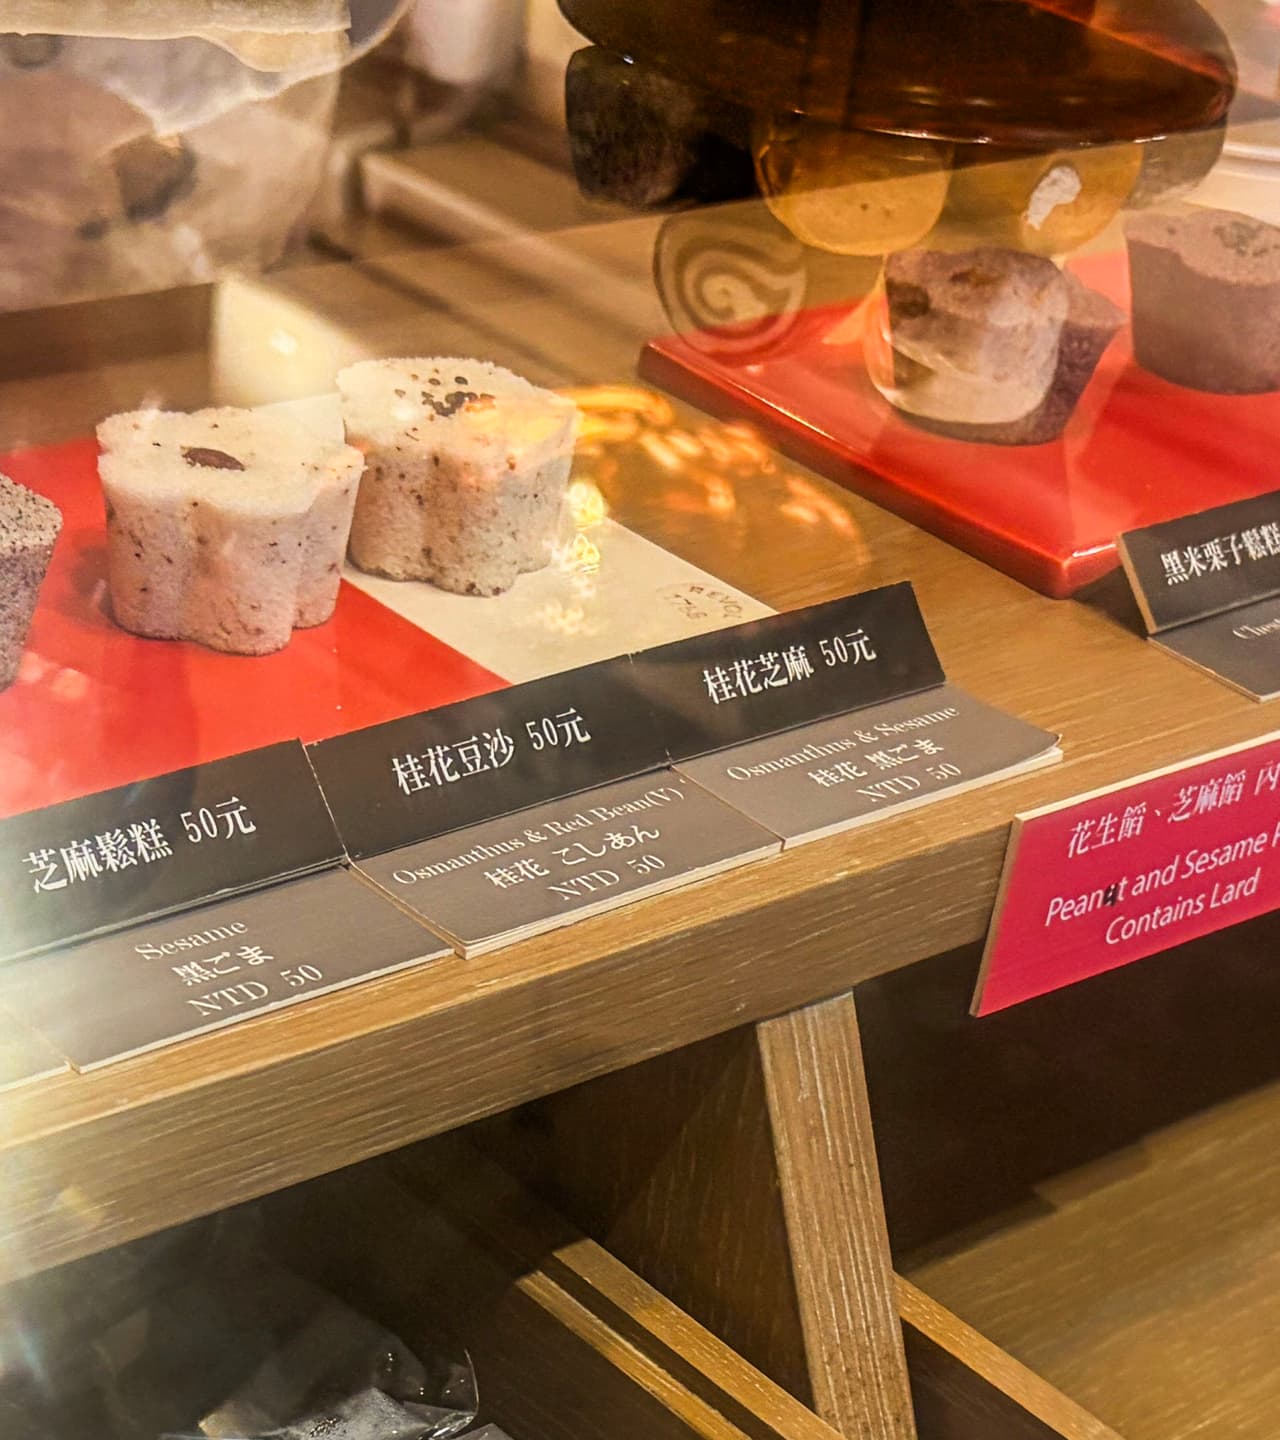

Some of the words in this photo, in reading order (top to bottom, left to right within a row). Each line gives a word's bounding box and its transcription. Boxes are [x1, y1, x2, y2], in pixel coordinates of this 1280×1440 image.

[703, 646, 815, 705] 桂花芝麻
[819, 628, 878, 668] 50元
[391, 729, 516, 797] 桂花豆沙
[525, 707, 592, 752] 50元
[726, 734, 855, 782] Osmanthus
[857, 728, 877, 745] &
[875, 705, 961, 738] Sesame
[807, 759, 868, 789] 桂花
[856, 774, 922, 804] NTD
[928, 762, 962, 783] 50
[22, 817, 174, 894] 芝麻鬆糕
[180, 795, 258, 845] 50元
[392, 828, 526, 886] Osmanthus
[526, 827, 547, 844] &
[549, 811, 592, 838] Red
[588, 786, 686, 824] Bean(V)
[483, 852, 552, 890] 桂花
[551, 822, 661, 864] こしあん
[1131, 855, 1181, 898] and
[1181, 831, 1268, 881] Sesame
[545, 867, 621, 902] NTD
[626, 852, 666, 876] 50
[1105, 893, 1205, 945] Contains
[1210, 868, 1262, 909] Lard
[134, 917, 249, 961] Sesame
[185, 979, 270, 1018] NTD
[281, 963, 324, 990] 50
